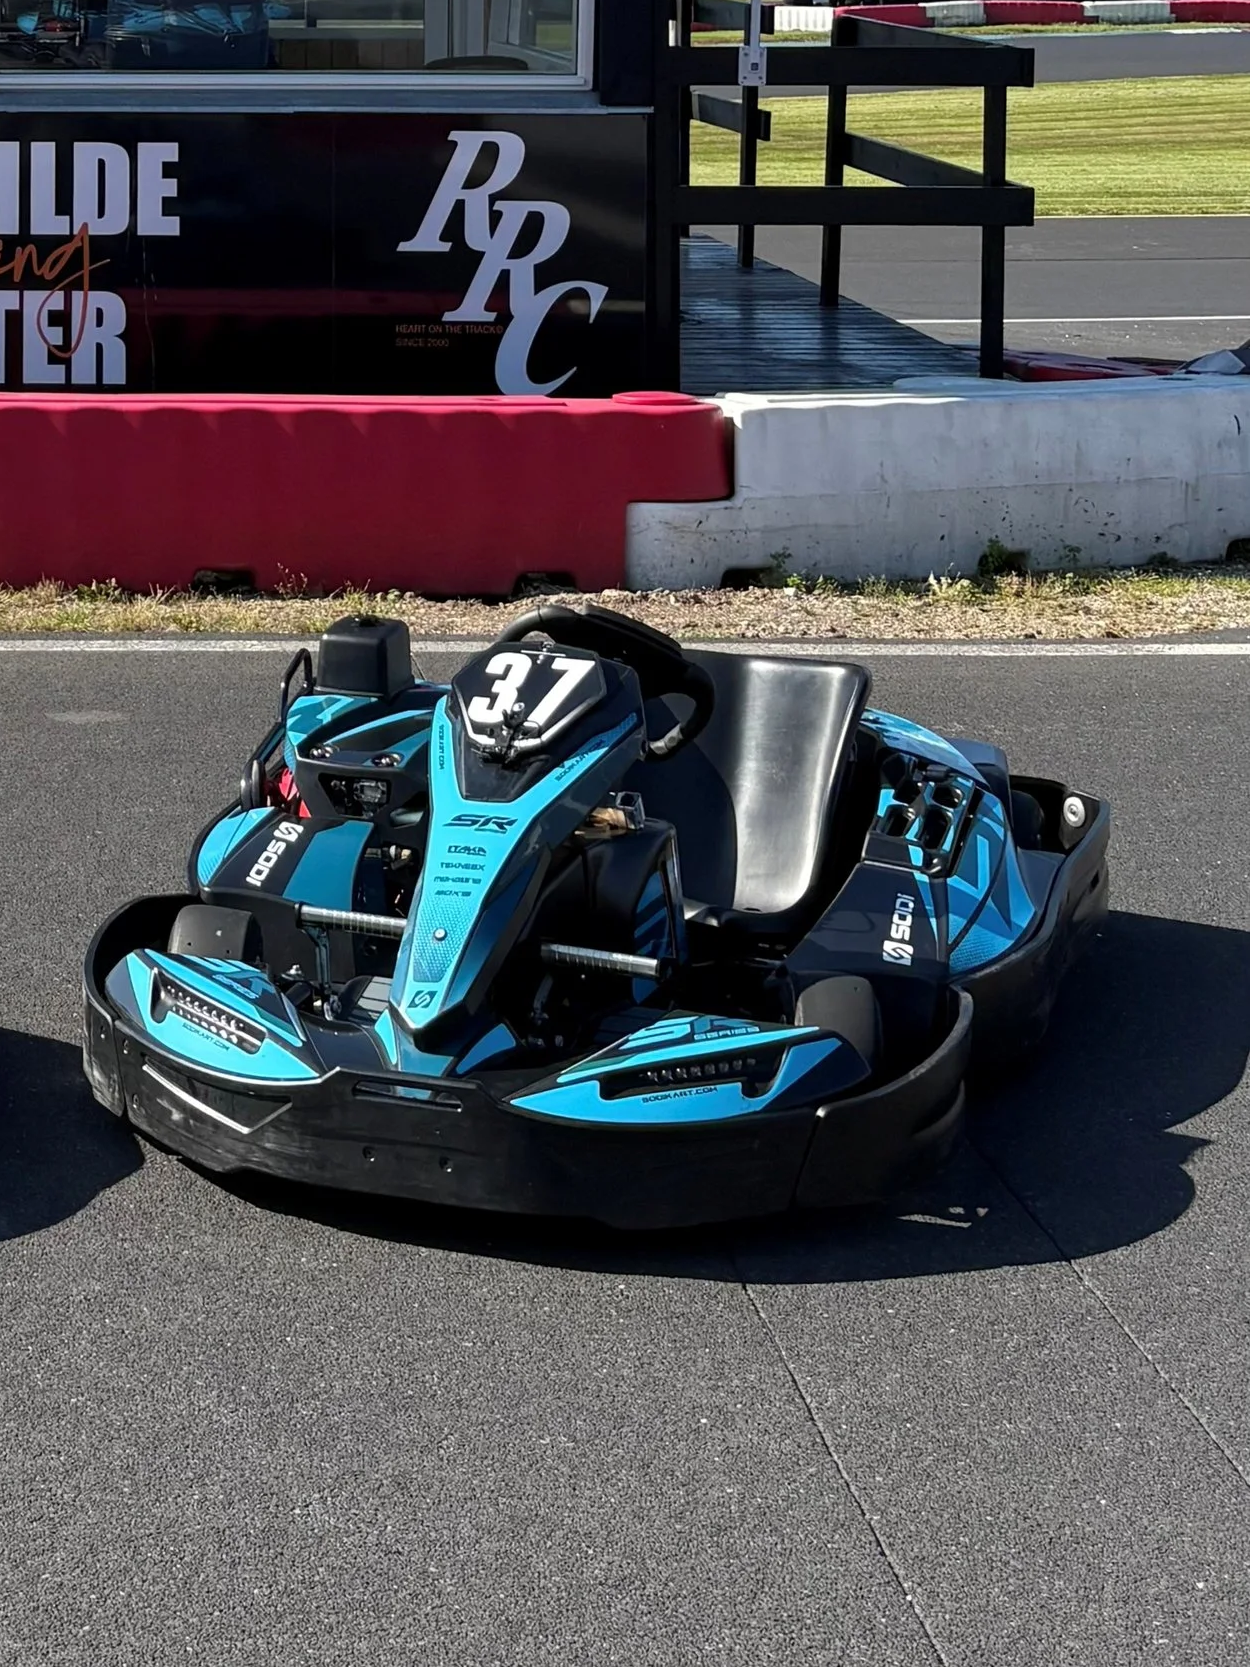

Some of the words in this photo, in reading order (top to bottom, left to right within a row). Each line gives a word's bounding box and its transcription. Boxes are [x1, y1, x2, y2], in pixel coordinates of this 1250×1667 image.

[396, 130, 609, 397] RRC
[395, 324, 427, 334] HEART
[428, 324, 443, 334] ON
[445, 324, 463, 334] THE
[395, 337, 426, 347] SINCE
[467, 652, 596, 727] 37
